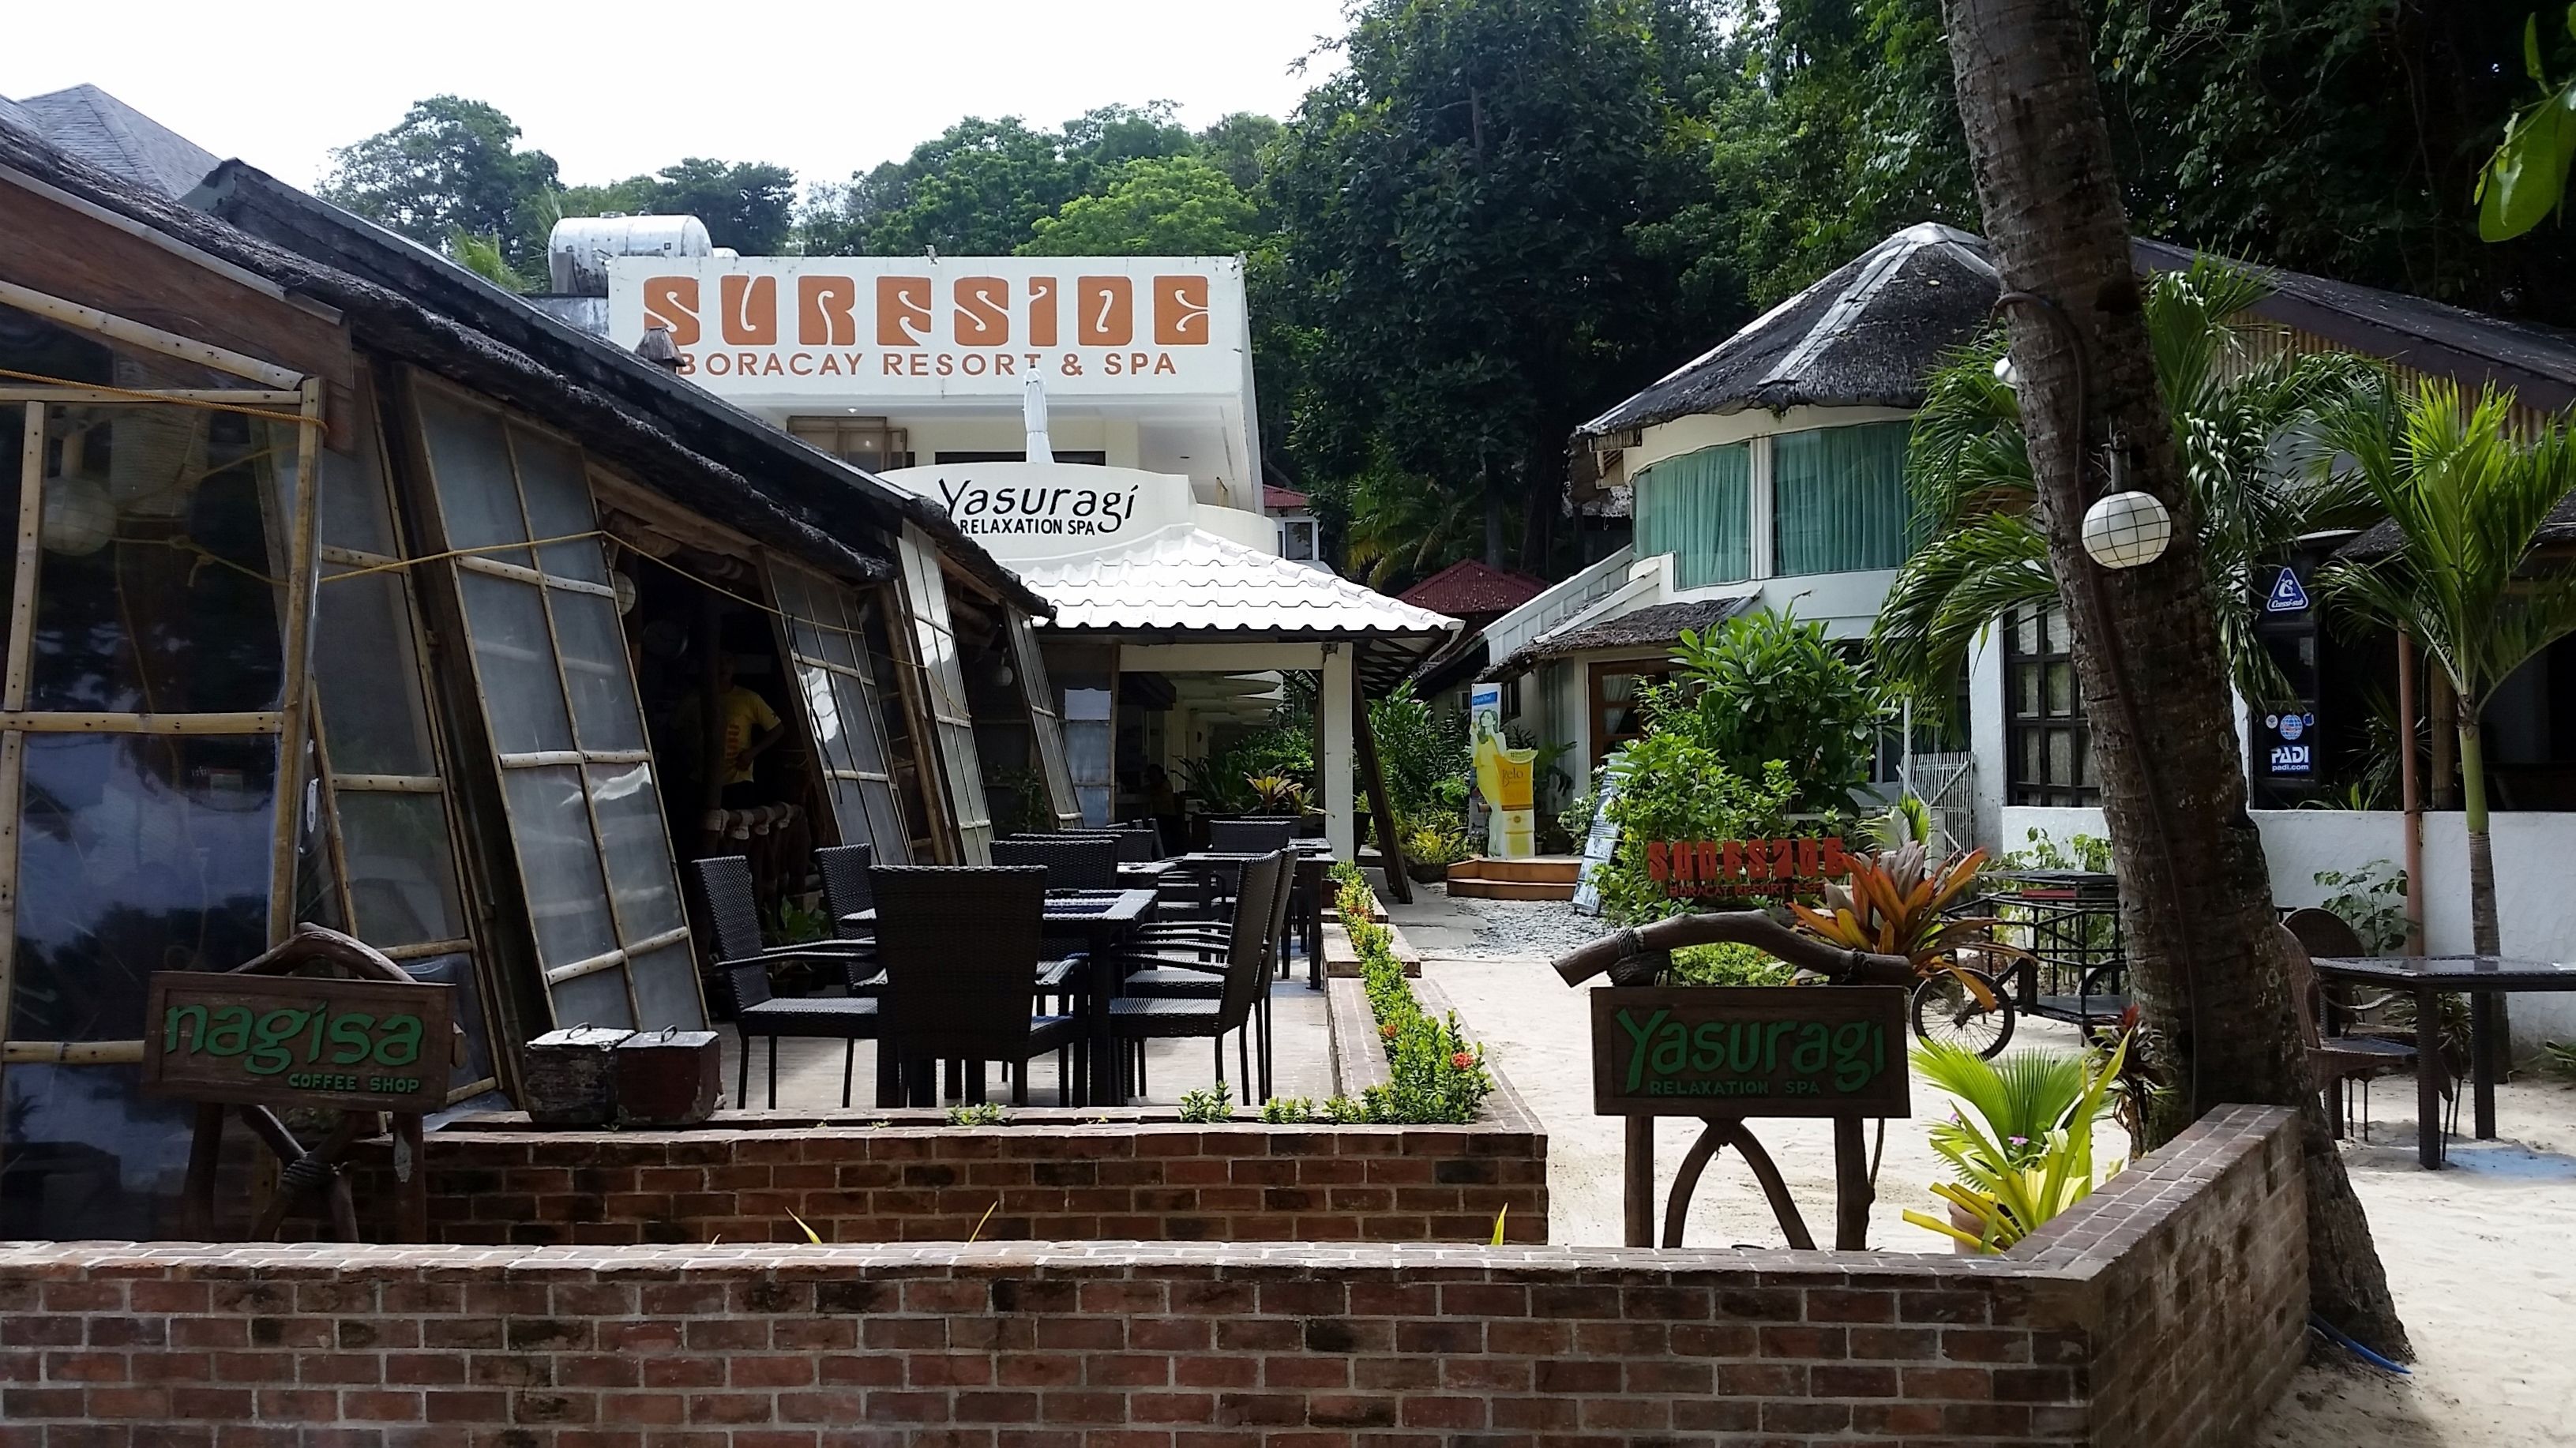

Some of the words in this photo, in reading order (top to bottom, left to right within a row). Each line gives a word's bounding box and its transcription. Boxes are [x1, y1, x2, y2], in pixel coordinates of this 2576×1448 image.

[643, 275, 1209, 347] SURFSIDE
[677, 353, 863, 377] BORACAY
[882, 353, 1042, 377] RESORT
[1061, 354, 1083, 377] &
[1104, 352, 1177, 376] SPA
[938, 478, 1139, 534] Yasuragi
[959, 518, 1063, 535] RELAXATION
[1068, 520, 1095, 536] SPA
[2270, 745, 2309, 764] PADI
[2271, 763, 2309, 772] padi.com
[1669, 885, 1729, 898] BORACAY
[1734, 883, 1787, 895] RESORT
[165, 1001, 422, 1075] nagisa
[1616, 1007, 1884, 1094] Yasuragi
[287, 1073, 355, 1090] COFFEE
[370, 1076, 419, 1093] SHOP
[1649, 1080, 1769, 1095] RELAXATION
[1785, 1080, 1821, 1094] SPA
